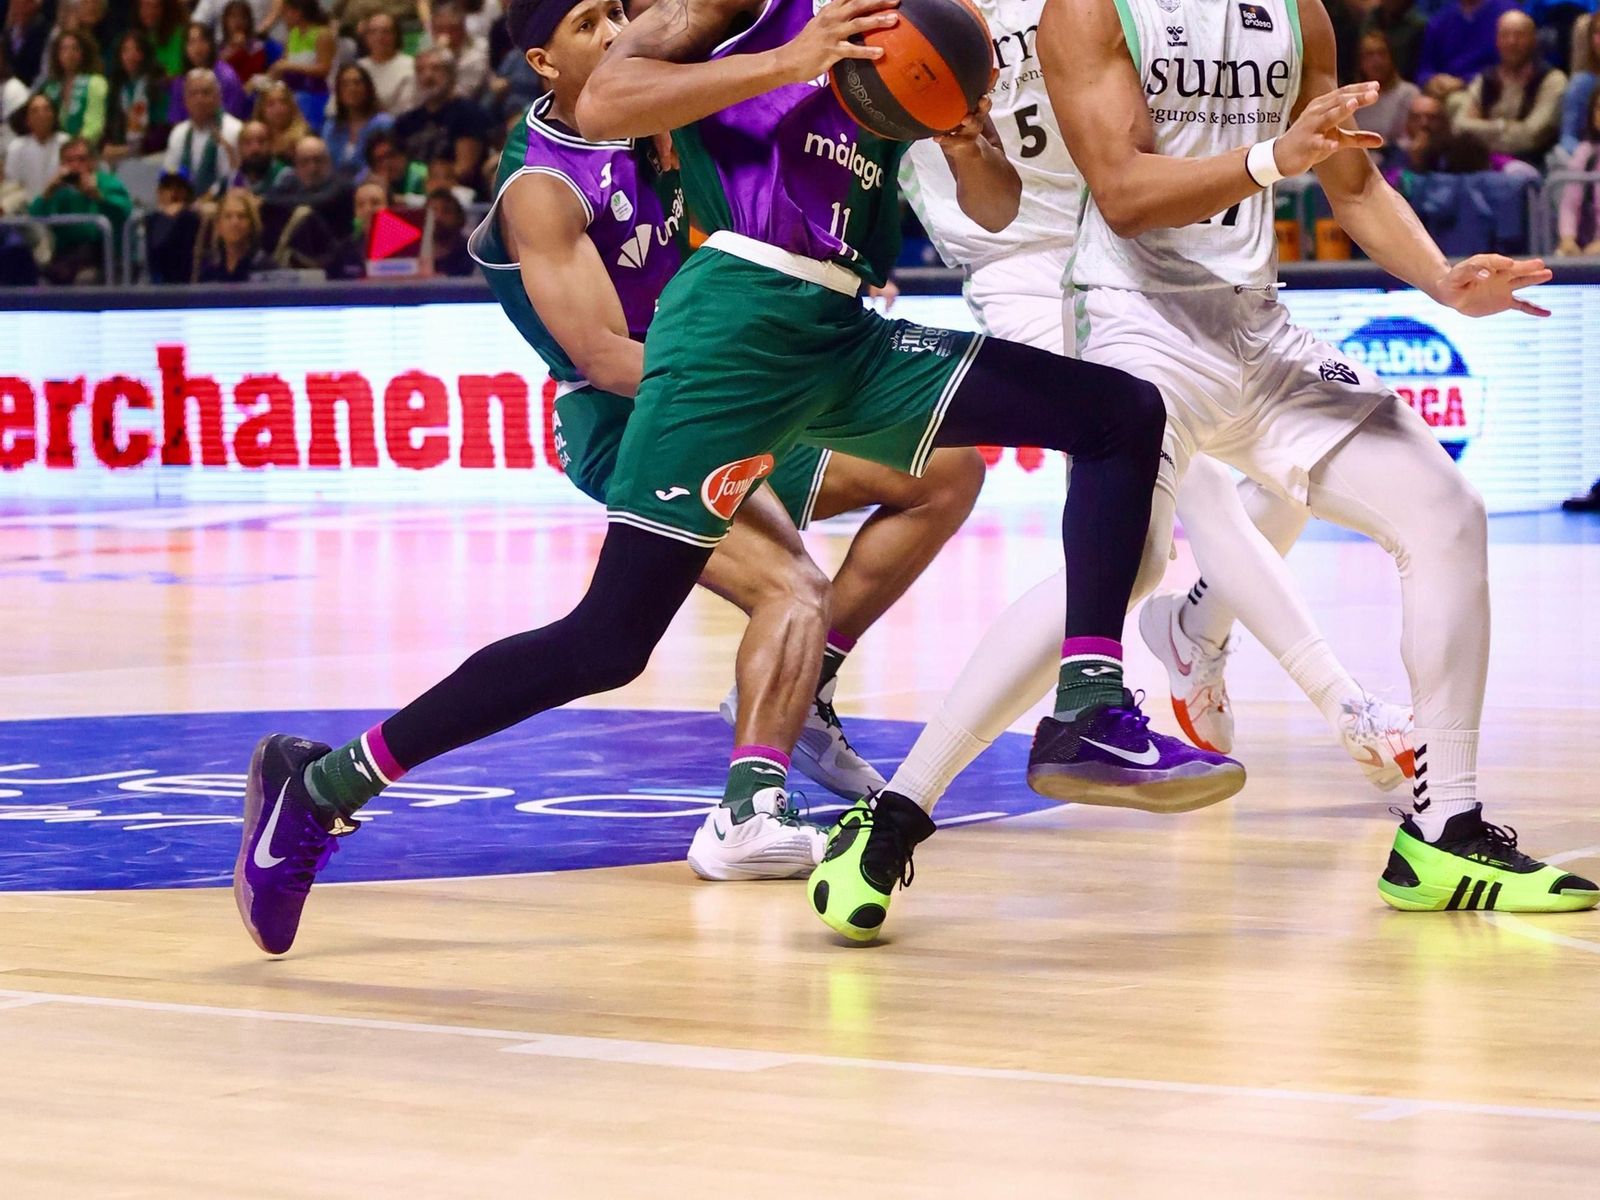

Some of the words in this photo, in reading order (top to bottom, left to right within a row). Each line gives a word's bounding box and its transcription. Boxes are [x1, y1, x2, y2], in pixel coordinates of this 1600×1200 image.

[1014, 103, 1047, 158] 5
[1149, 107, 1207, 125] eguros
[1209, 113, 1221, 124] &
